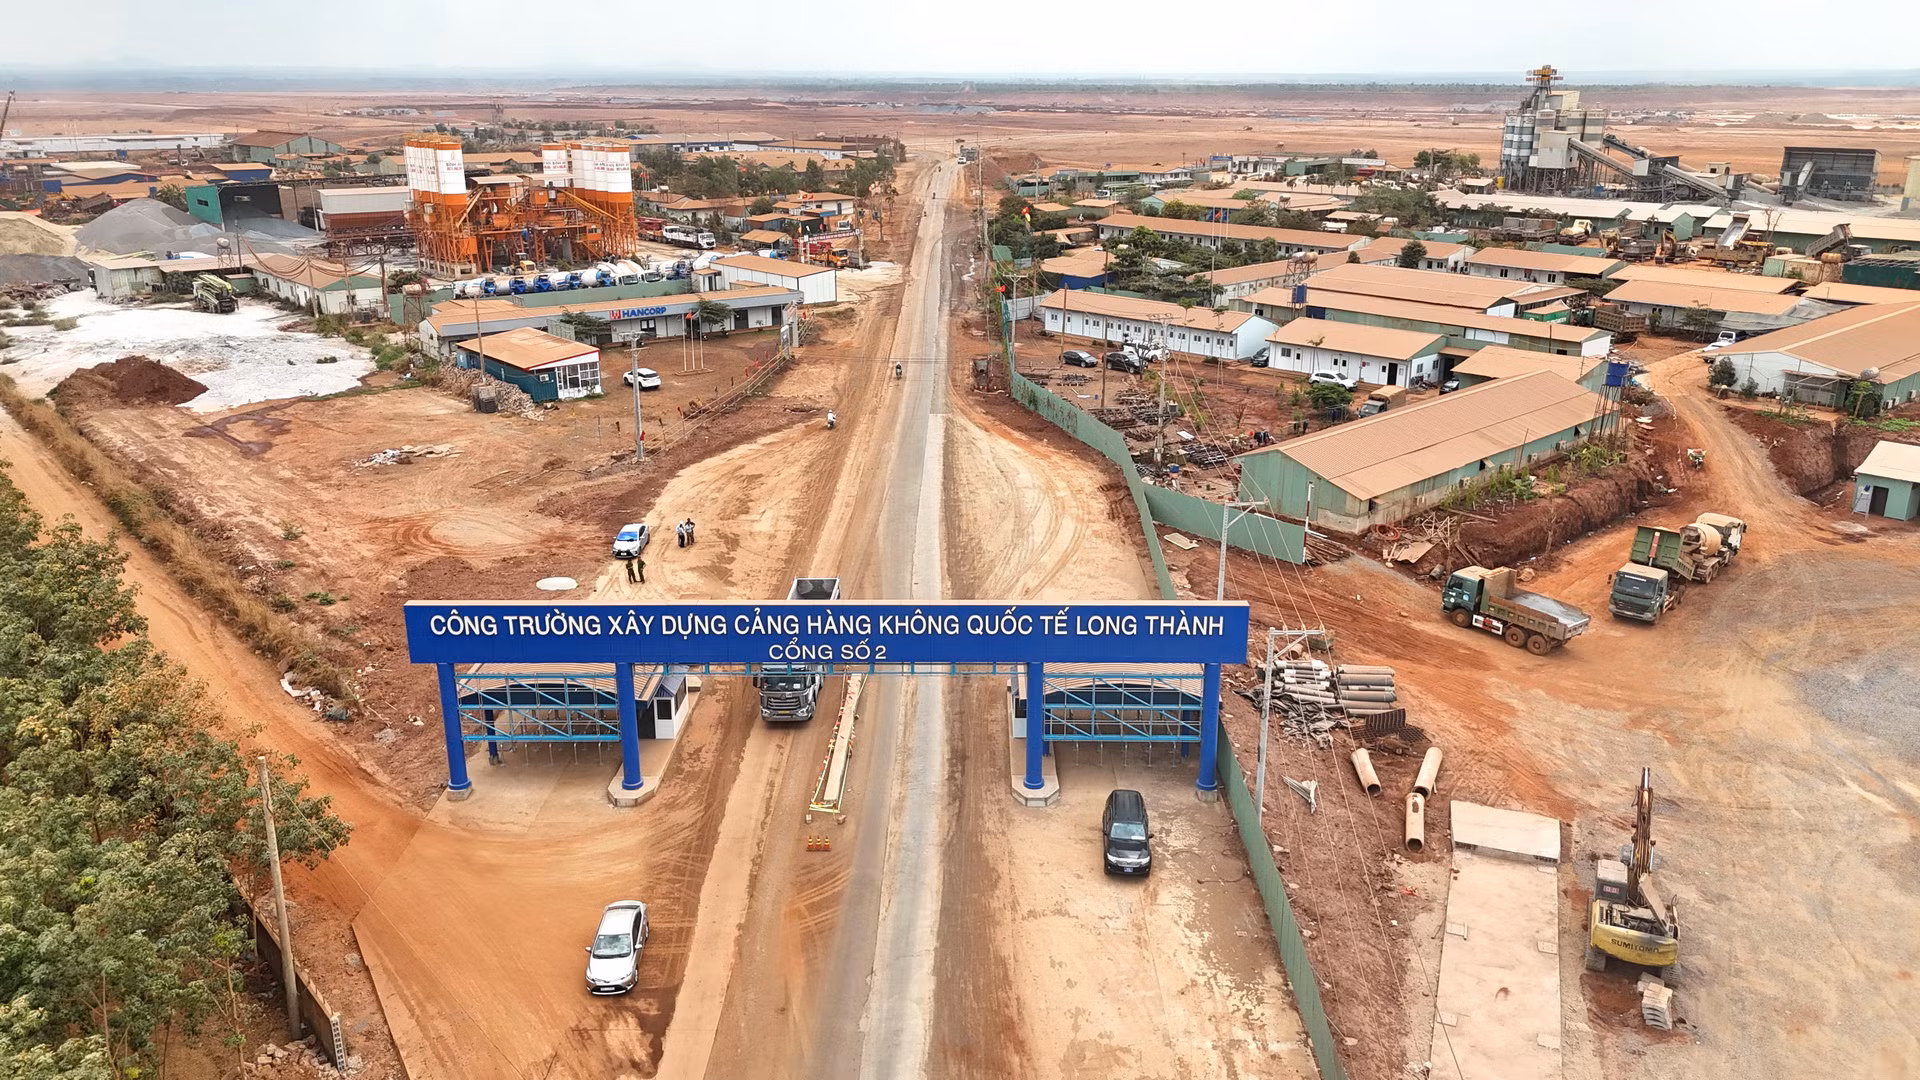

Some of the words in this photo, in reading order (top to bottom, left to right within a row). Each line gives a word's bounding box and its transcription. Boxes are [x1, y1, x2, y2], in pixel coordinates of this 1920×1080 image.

[622, 307, 667, 317] HANCORP
[430, 609, 498, 635] CÔNG
[503, 609, 602, 635] TRƯỜNG
[608, 610, 655, 635] XÂY
[661, 613, 727, 640] DỰNG
[734, 608, 799, 635] CẢNG
[807, 609, 872, 635] HÀNG
[879, 609, 960, 635] KHÔNG
[967, 607, 1033, 635] QUỐC
[1039, 607, 1069, 635] TẾ
[1076, 615, 1137, 635] LONG
[1144, 610, 1224, 636] THÀNH
[768, 637, 833, 660] CỔNG
[840, 638, 871, 660] SỐ
[875, 645, 887, 660] 2
